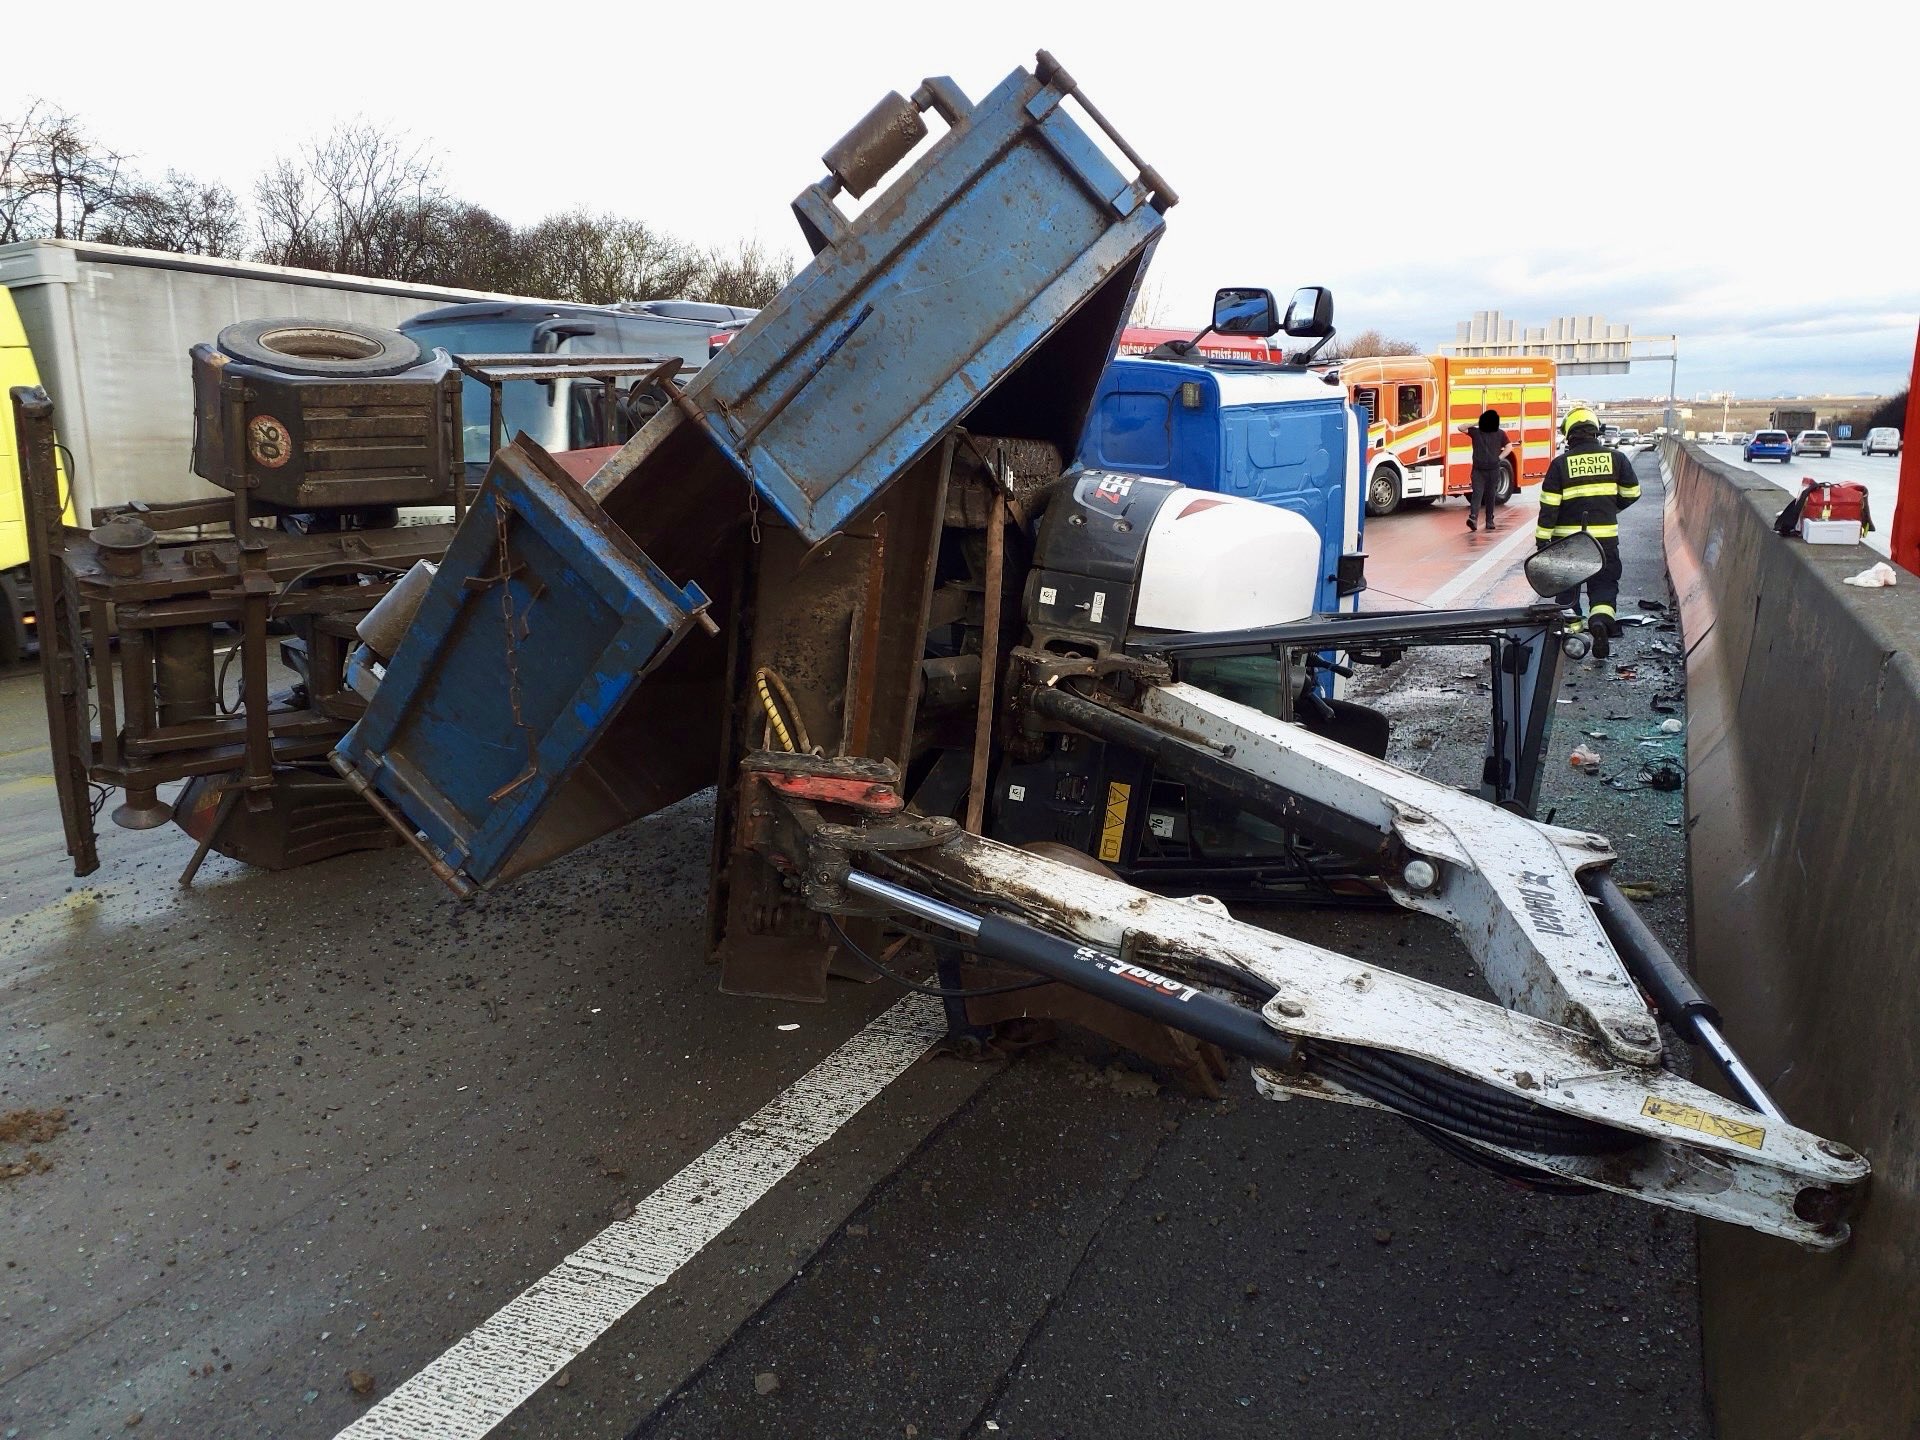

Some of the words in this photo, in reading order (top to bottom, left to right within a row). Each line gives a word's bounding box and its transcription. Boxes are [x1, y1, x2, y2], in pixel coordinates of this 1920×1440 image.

[1502, 391, 1513, 401] 112
[1570, 464, 1611, 476] PRAHA
[1151, 818, 1164, 830] 94
[1517, 887, 1574, 938] Bobcat
